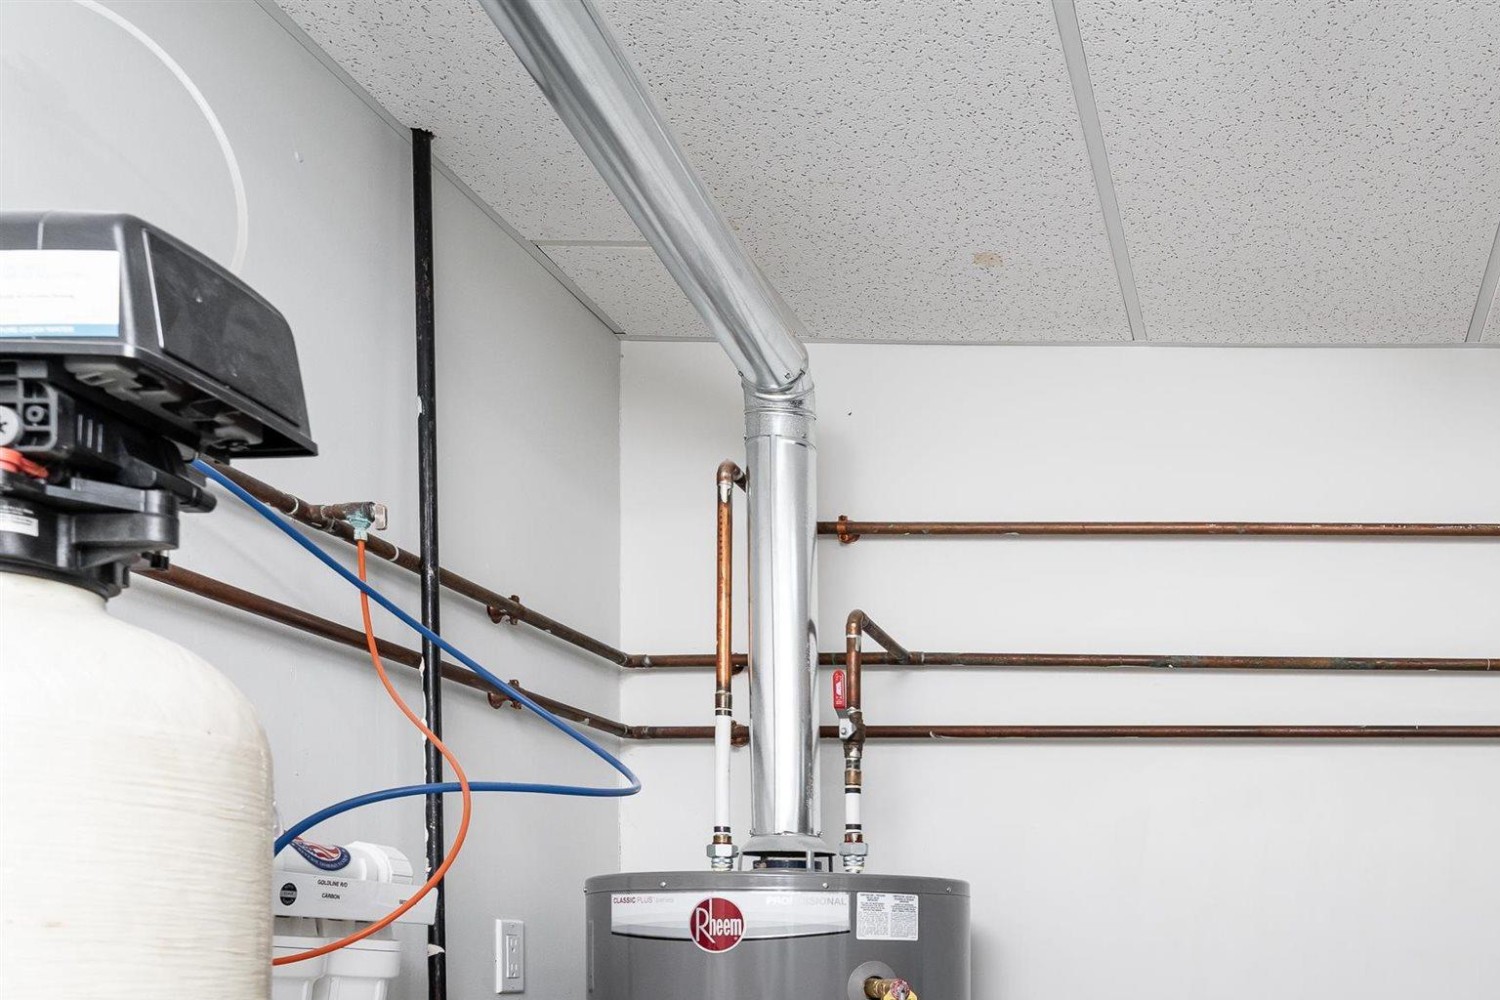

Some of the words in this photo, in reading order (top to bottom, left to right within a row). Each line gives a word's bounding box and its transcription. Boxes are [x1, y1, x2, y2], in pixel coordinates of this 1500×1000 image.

[317, 879, 339, 887] GOLDLINE
[766, 895, 847, 906] PROSIONAL
[695, 899, 742, 943] Rheem
